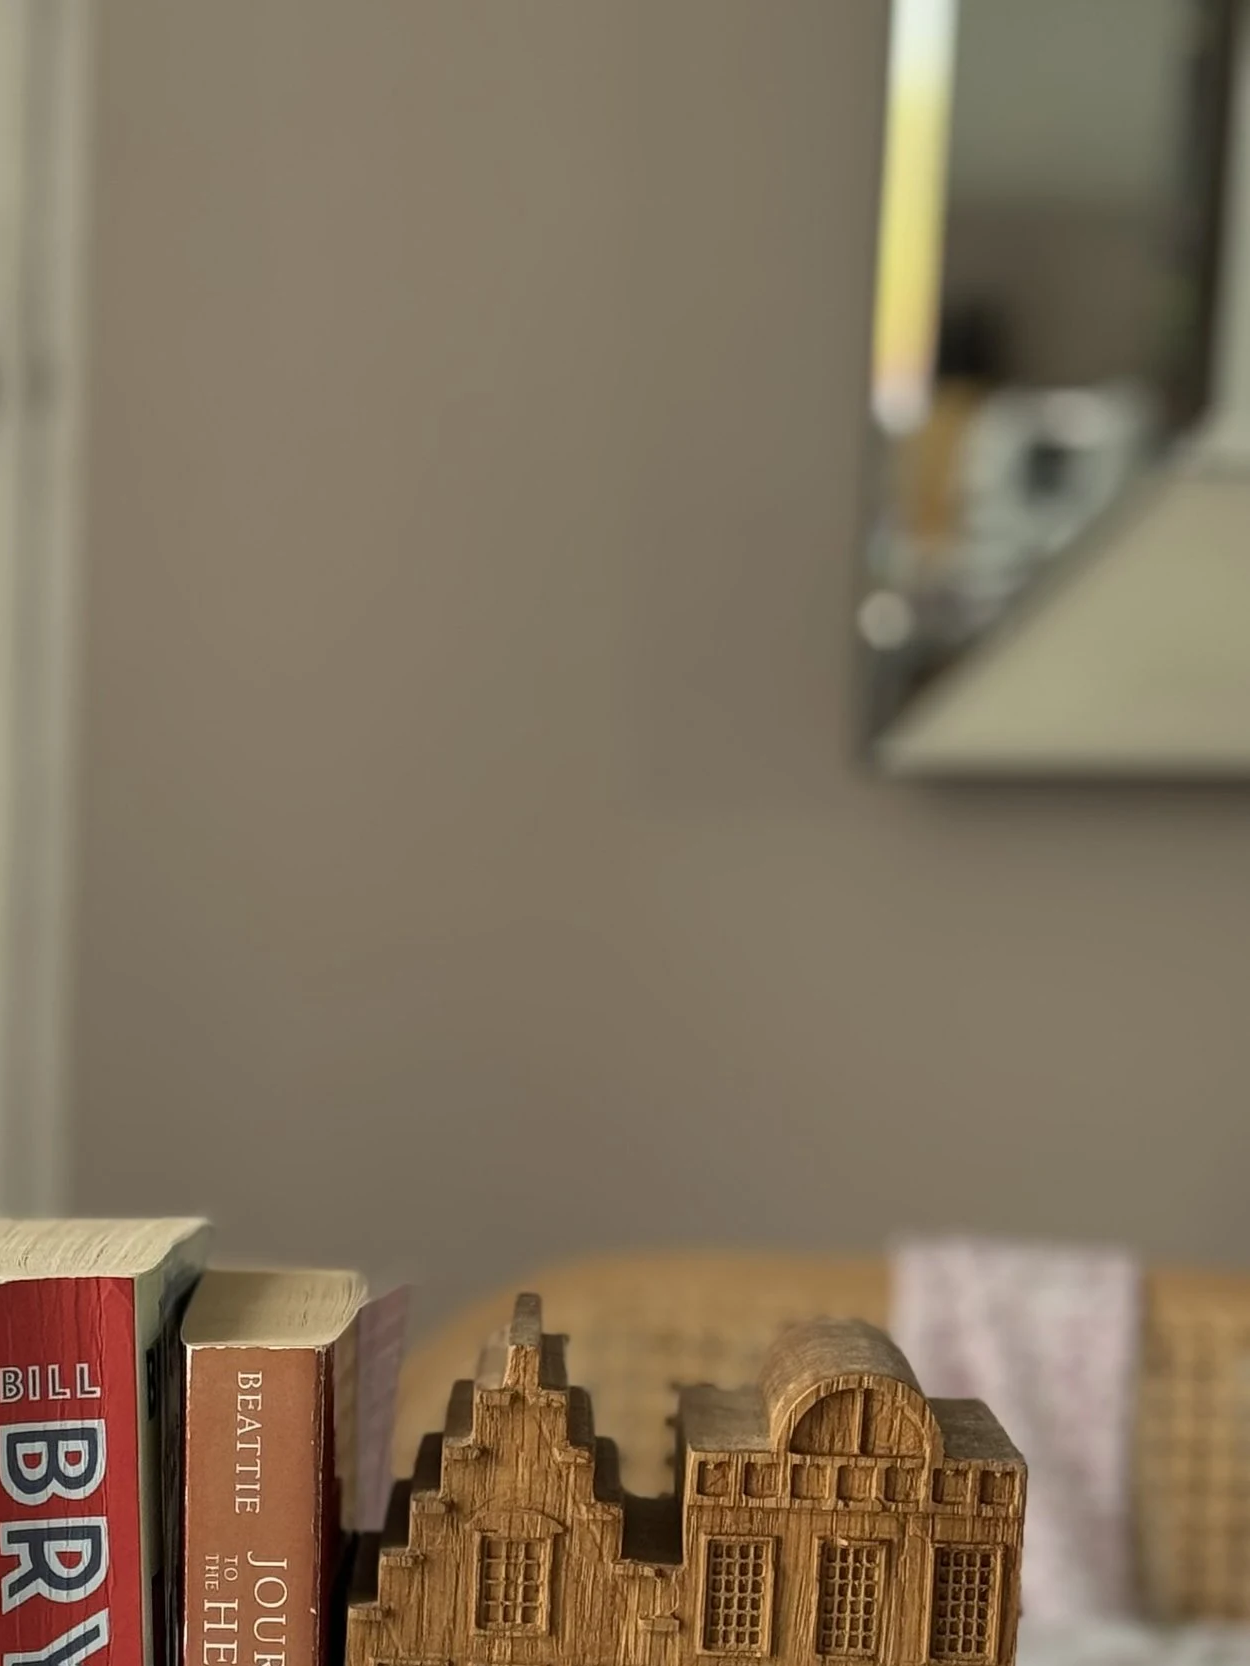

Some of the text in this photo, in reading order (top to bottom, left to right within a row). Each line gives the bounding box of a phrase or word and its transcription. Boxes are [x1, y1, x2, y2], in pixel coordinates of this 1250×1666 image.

[235, 1371, 263, 1514] BEATTIE
[205, 1554, 220, 1591] THE
[224, 1554, 239, 1581] TO
